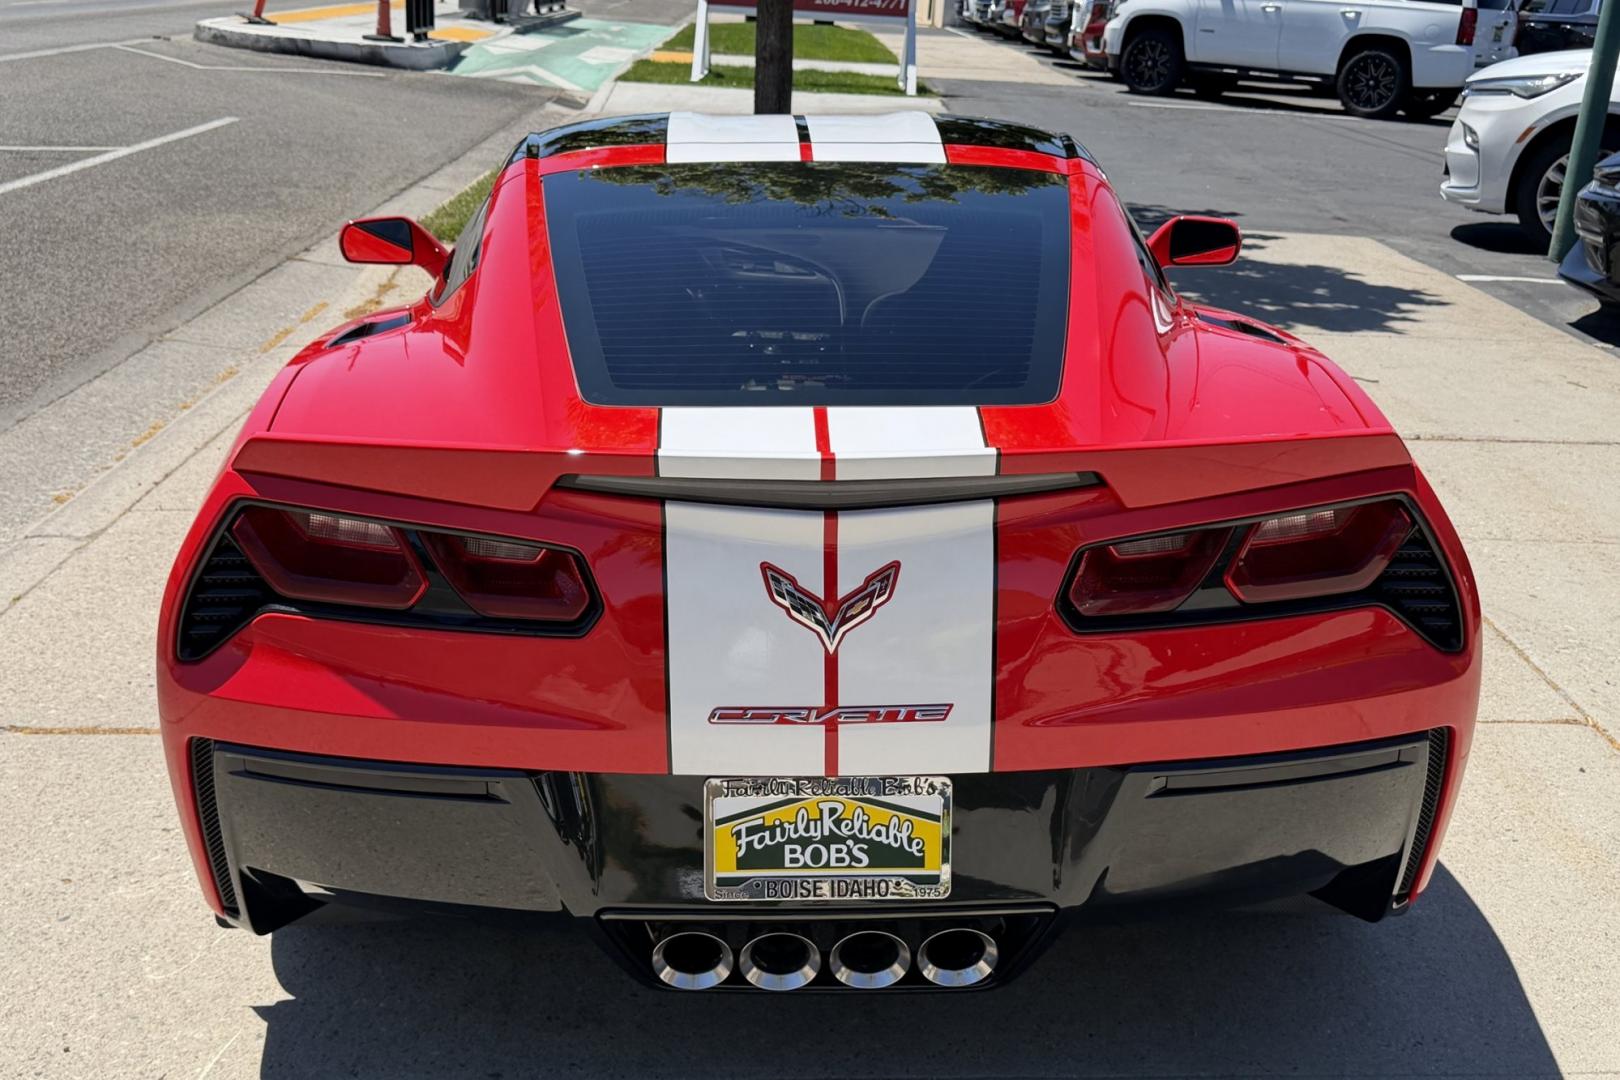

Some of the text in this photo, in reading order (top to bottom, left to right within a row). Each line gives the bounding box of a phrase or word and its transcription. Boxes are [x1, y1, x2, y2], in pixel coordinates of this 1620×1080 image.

[708, 703, 954, 724] CORVETTE
[720, 777, 938, 798] Fairly Reliable Bob's
[783, 840, 870, 869] BOB'S
[766, 879, 889, 898] BOISE IDAHO
[913, 887, 941, 898] 1975
